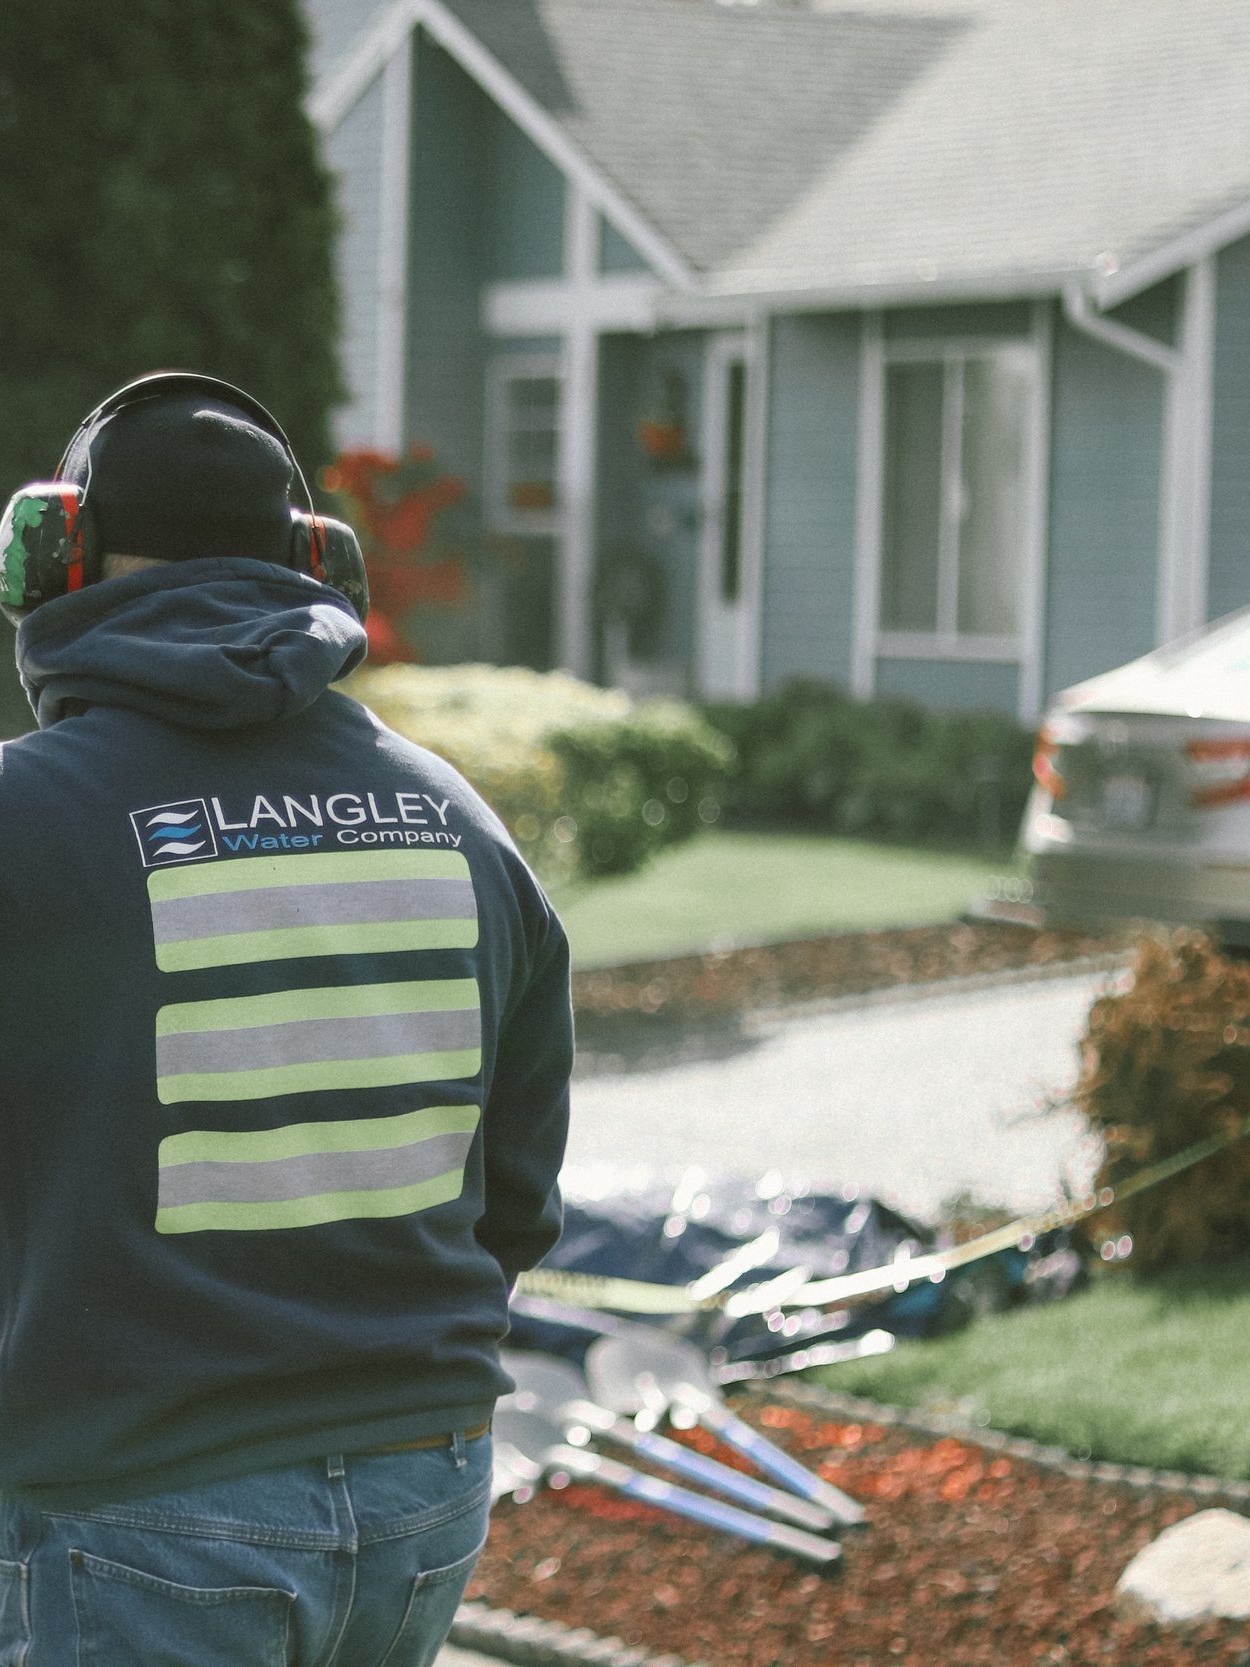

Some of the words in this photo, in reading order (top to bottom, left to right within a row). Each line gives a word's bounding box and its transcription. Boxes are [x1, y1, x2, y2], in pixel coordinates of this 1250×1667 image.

[211, 792, 450, 831] LANGLEY
[222, 832, 323, 851] Water
[336, 829, 462, 848] Company
